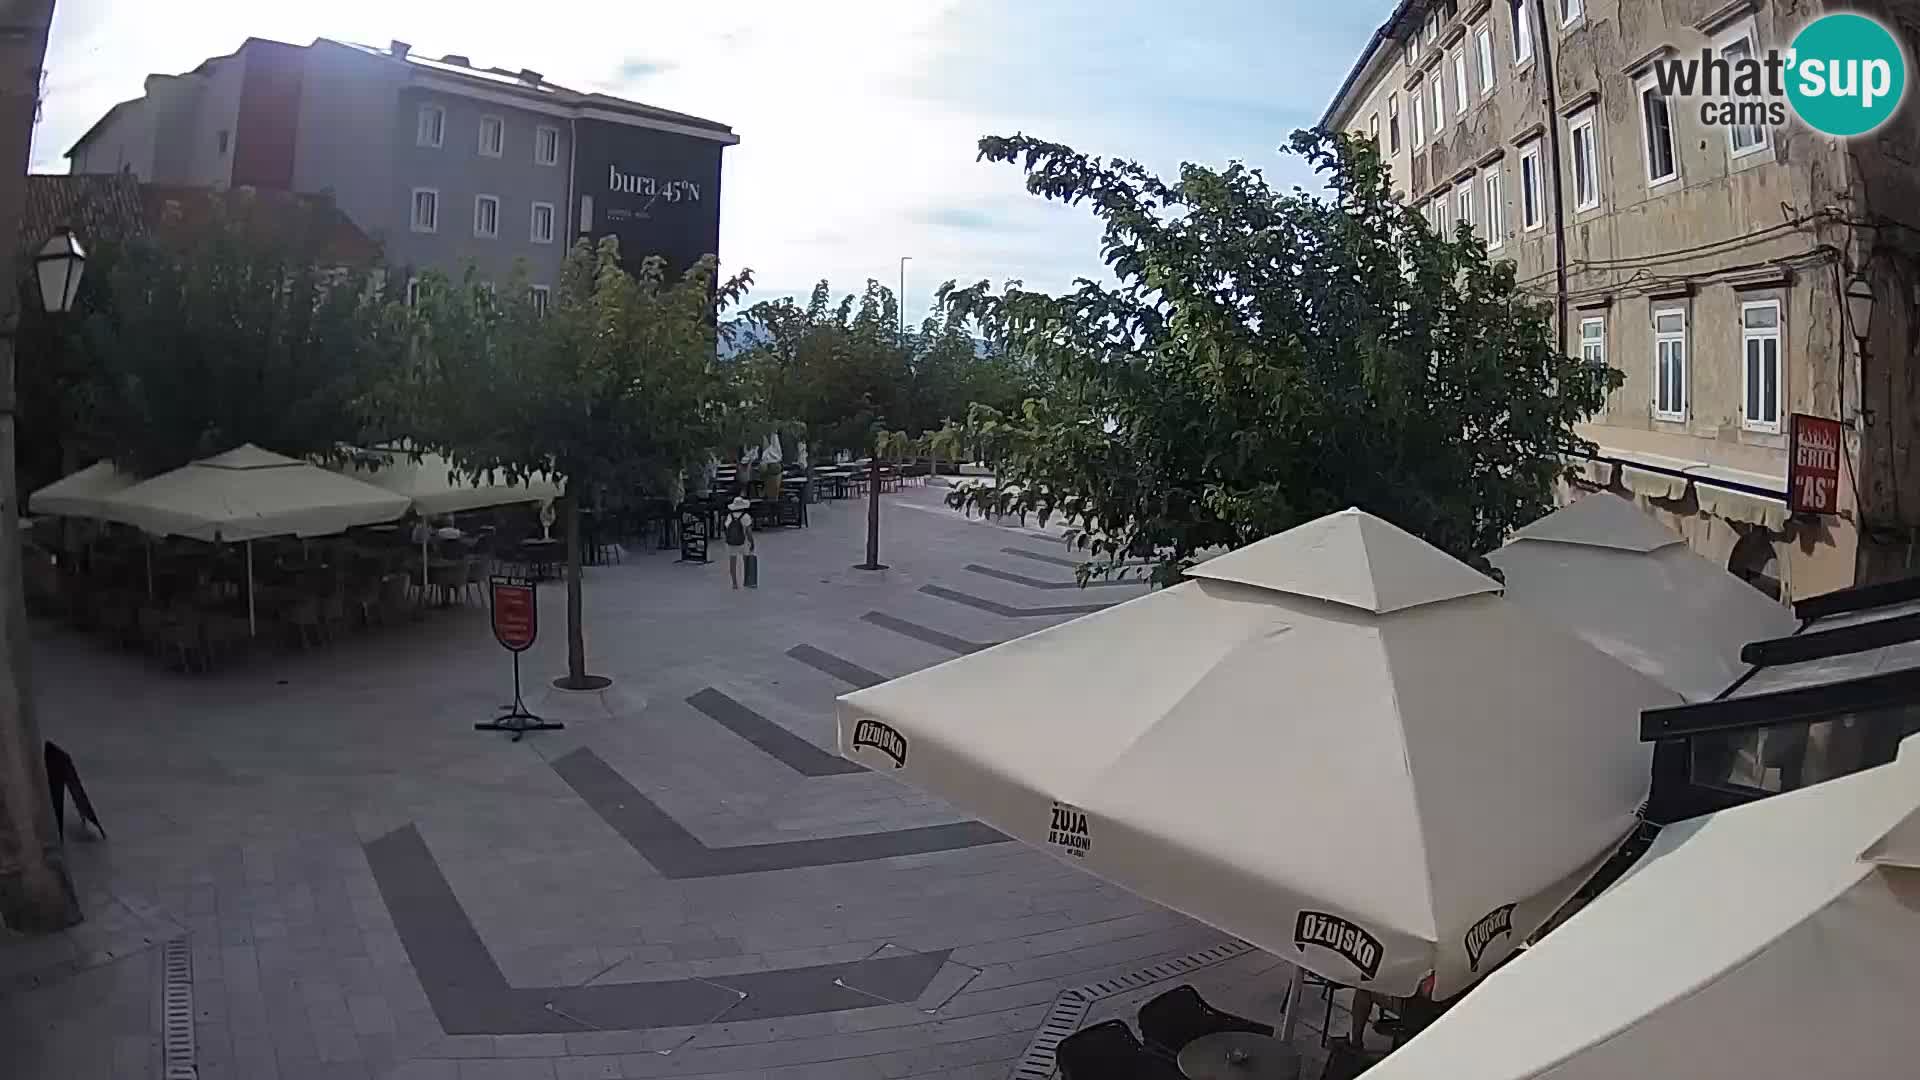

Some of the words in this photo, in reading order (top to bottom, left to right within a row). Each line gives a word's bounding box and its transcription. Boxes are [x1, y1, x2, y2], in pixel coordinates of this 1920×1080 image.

[609, 164, 656, 196] bura
[1797, 447, 1837, 470] GRILL
[858, 721, 903, 758] Ožujsko
[1050, 800, 1089, 836] ŽUJA
[1048, 830, 1058, 844] JE
[1058, 832, 1091, 851] ZAKON!
[1302, 914, 1375, 970] Ožujsko
